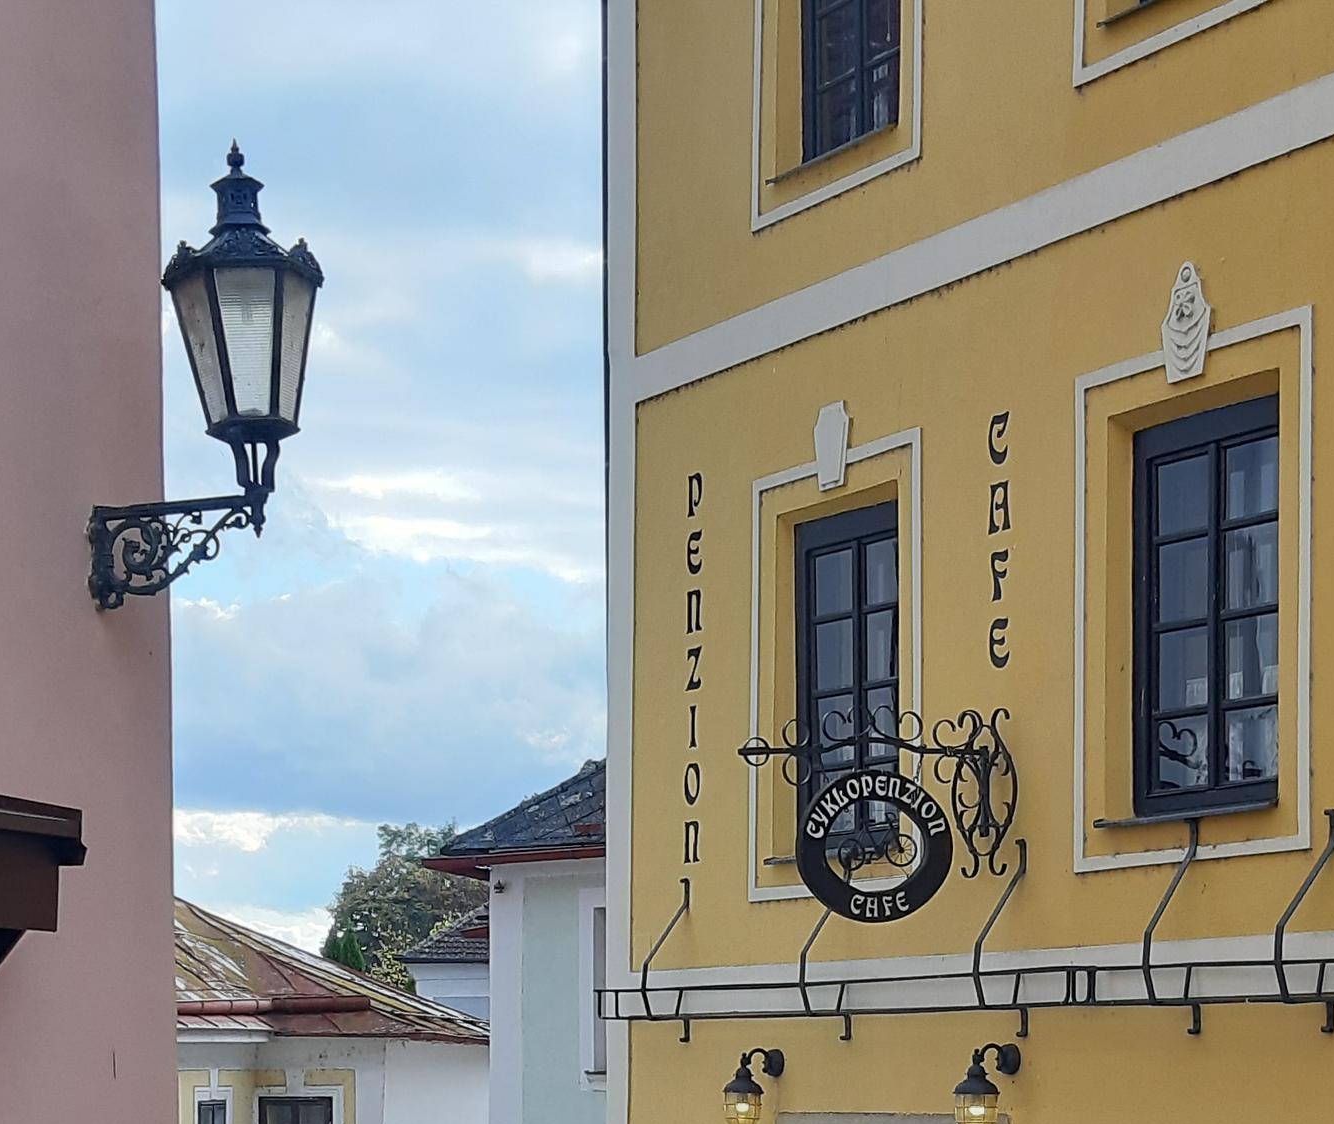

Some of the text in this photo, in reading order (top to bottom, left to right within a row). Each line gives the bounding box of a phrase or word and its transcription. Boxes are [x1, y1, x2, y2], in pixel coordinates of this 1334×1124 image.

[987, 410, 1012, 669] CAFE
[683, 472, 704, 864] PENZION
[805, 774, 947, 840] CYKLOPENZION
[849, 890, 910, 918] CAFE
